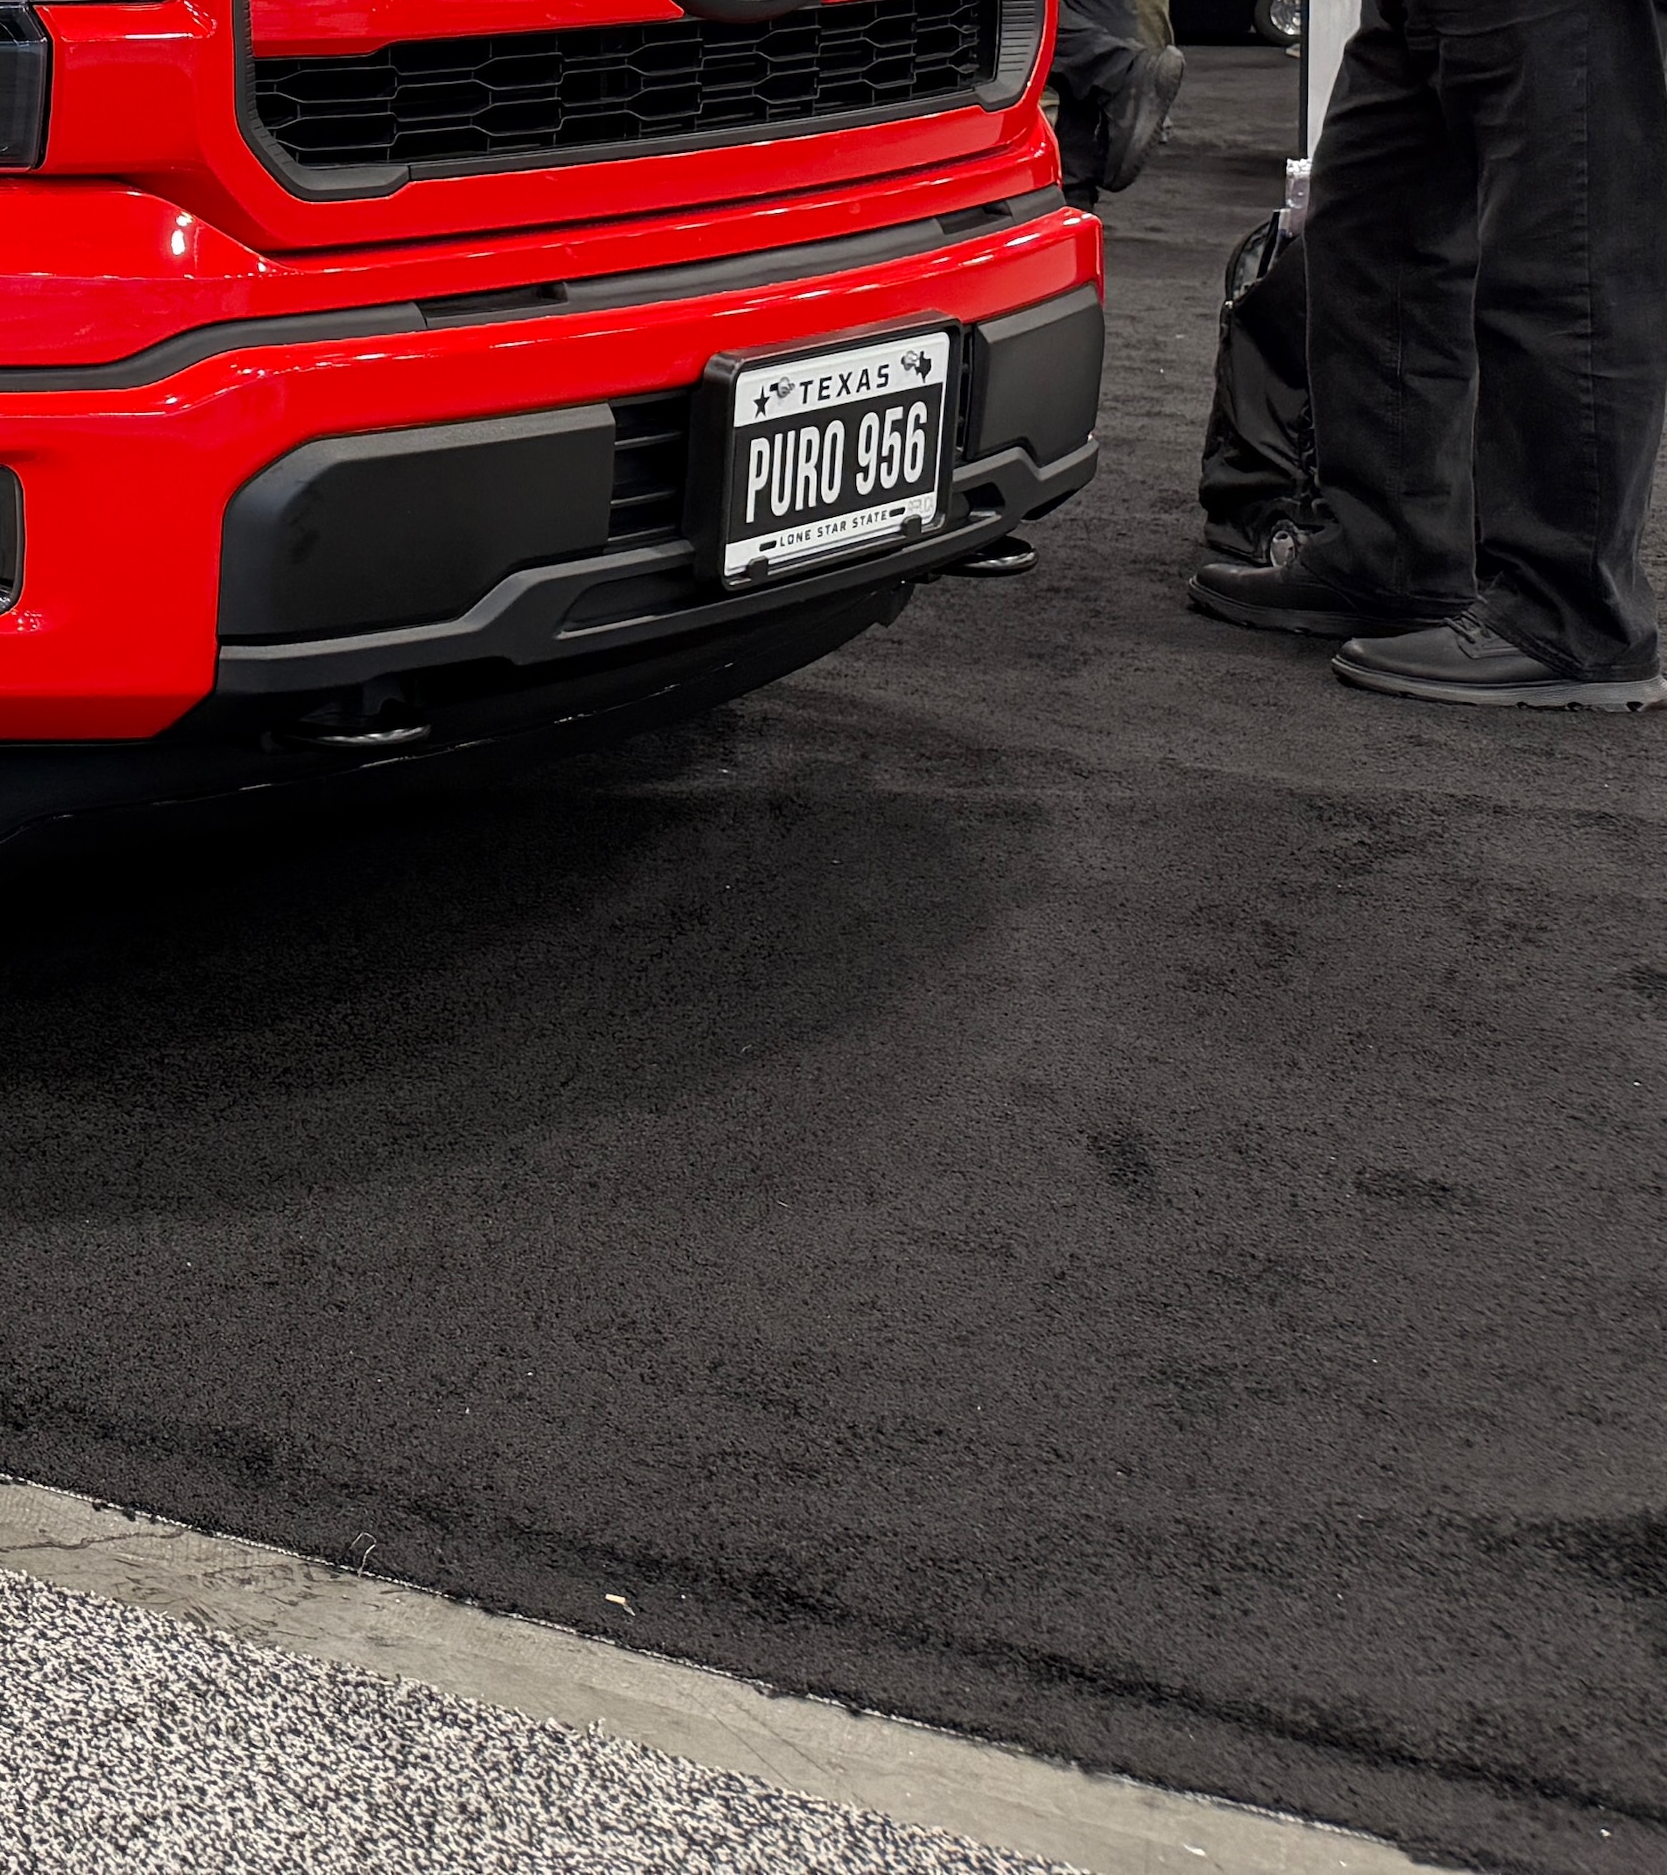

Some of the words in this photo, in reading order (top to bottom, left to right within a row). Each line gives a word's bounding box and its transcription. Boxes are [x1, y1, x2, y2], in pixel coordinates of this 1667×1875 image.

[799, 364, 890, 404] TEXAS
[746, 420, 845, 524] PURO
[856, 401, 928, 495] 956
[780, 529, 811, 548] LONE
[818, 520, 847, 537] STAR
[852, 510, 887, 528] STATE
